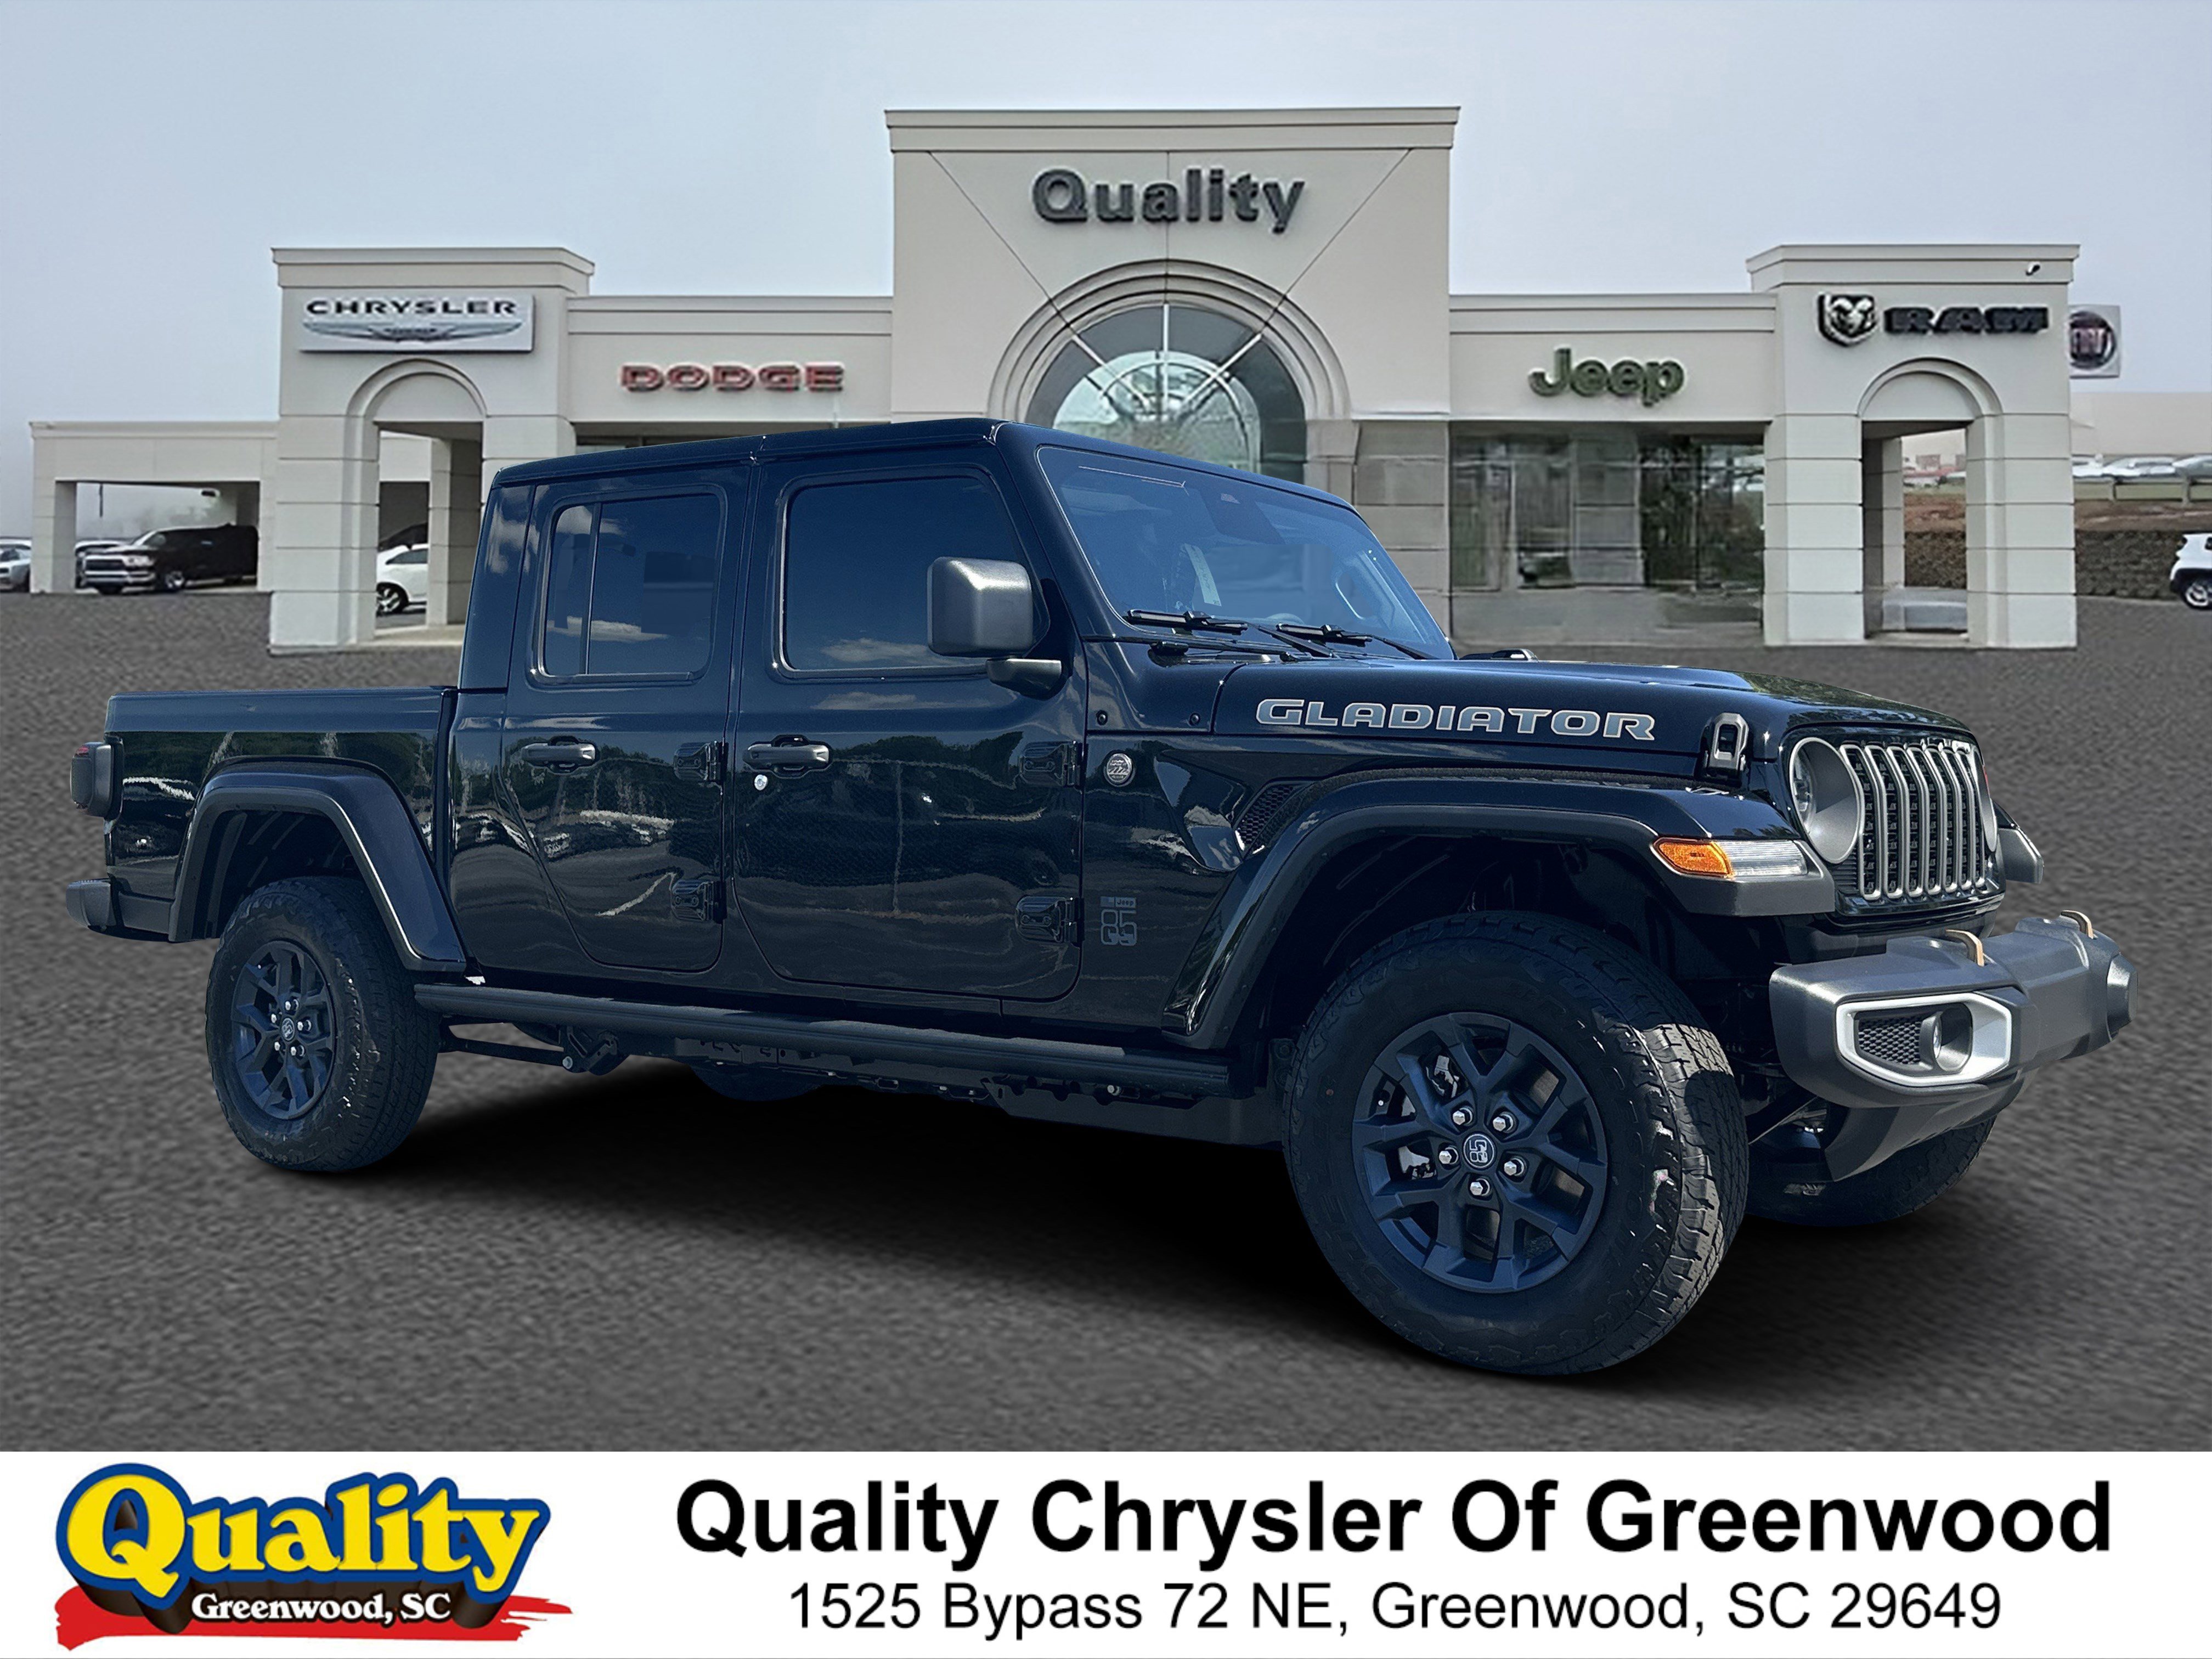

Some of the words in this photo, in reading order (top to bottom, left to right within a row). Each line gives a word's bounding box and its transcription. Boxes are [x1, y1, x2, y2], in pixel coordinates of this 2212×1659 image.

[1032, 168, 1305, 234] Quality
[306, 300, 517, 316] CHRYSLER
[1884, 306, 2049, 335] RAM
[620, 363, 845, 393] DODGE
[1528, 347, 1684, 407] Jeep
[1256, 698, 1656, 741] GLADIATOR
[1101, 909, 1137, 946] 85
